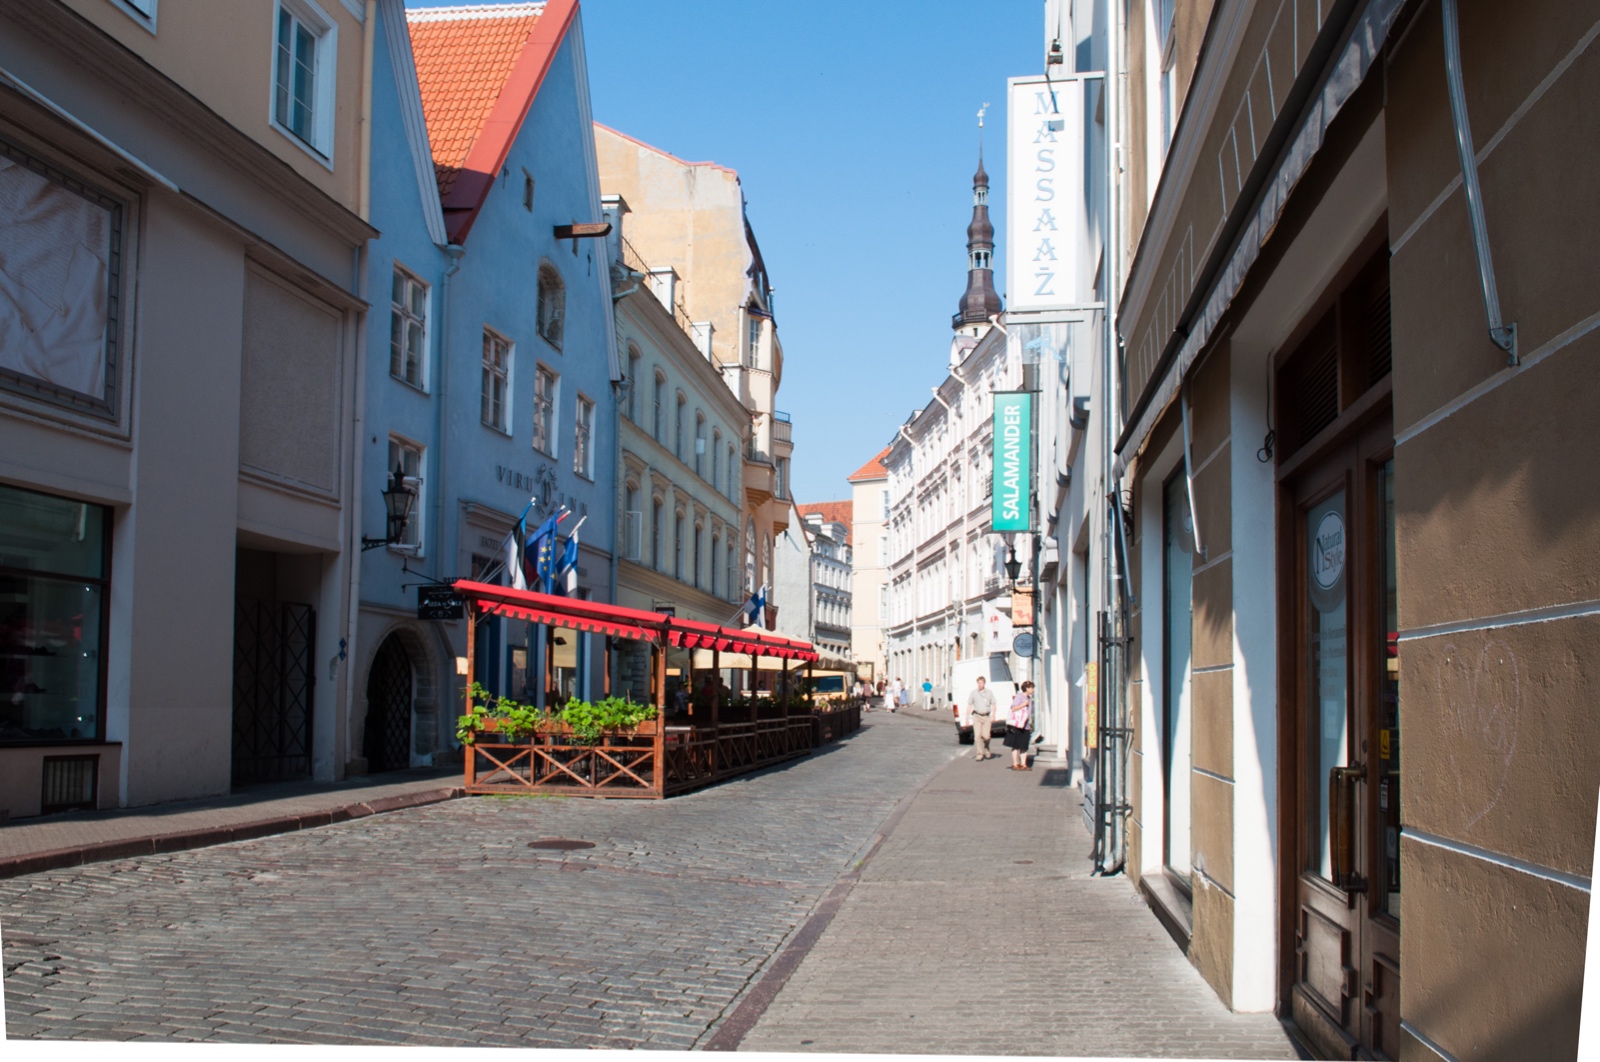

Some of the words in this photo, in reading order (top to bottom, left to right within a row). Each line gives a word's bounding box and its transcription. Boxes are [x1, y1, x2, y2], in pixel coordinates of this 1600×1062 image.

[1002, 405, 1021, 520] SALAMANDER
[496, 465, 533, 494] VIRU
[559, 492, 588, 516] INN
[1316, 526, 1343, 575] Natural
[1324, 547, 1343, 573] Style
